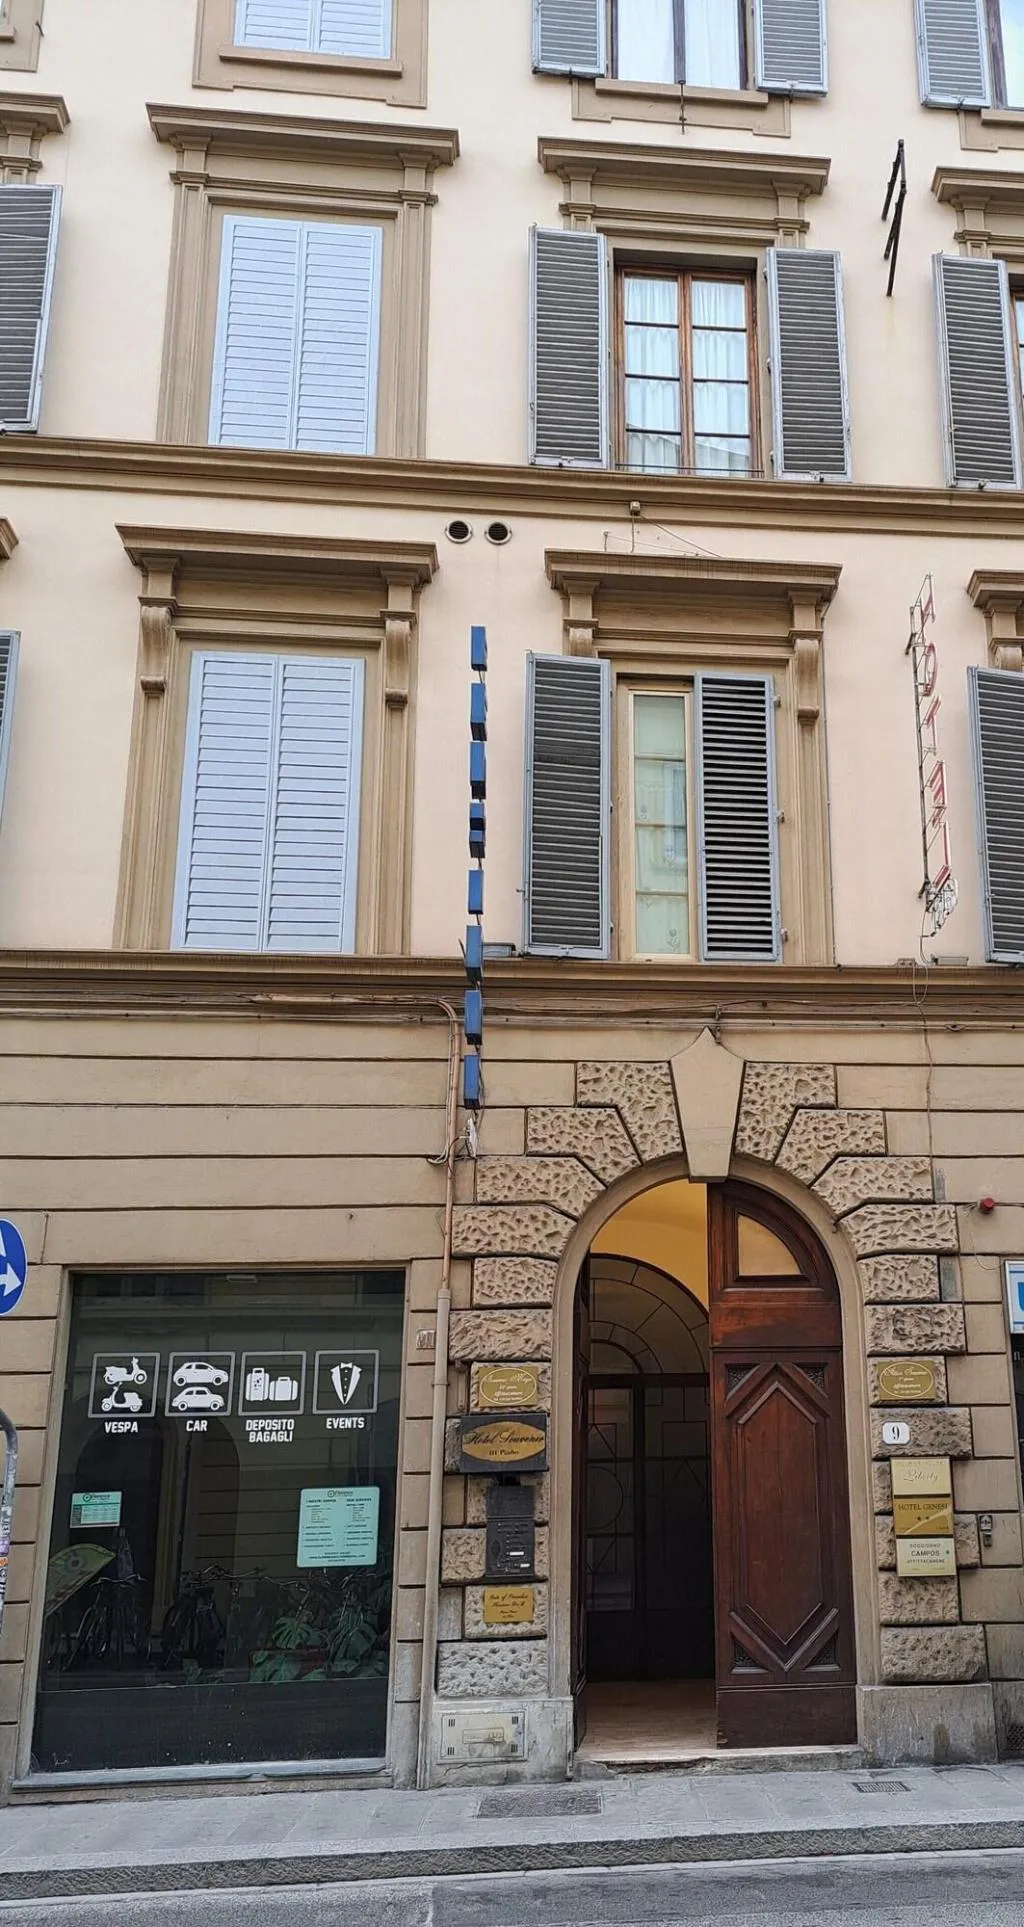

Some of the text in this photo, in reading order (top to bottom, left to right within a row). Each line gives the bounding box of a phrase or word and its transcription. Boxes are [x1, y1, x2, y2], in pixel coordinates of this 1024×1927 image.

[104, 1421, 138, 1433] VESPA
[186, 1420, 208, 1432] CAR
[245, 1419, 295, 1431] DEPOSITO
[326, 1417, 365, 1429] EVENTS
[249, 1431, 293, 1442] BAGAGLI
[892, 1426, 900, 1440] 9
[898, 1503, 922, 1511] HOTEL
